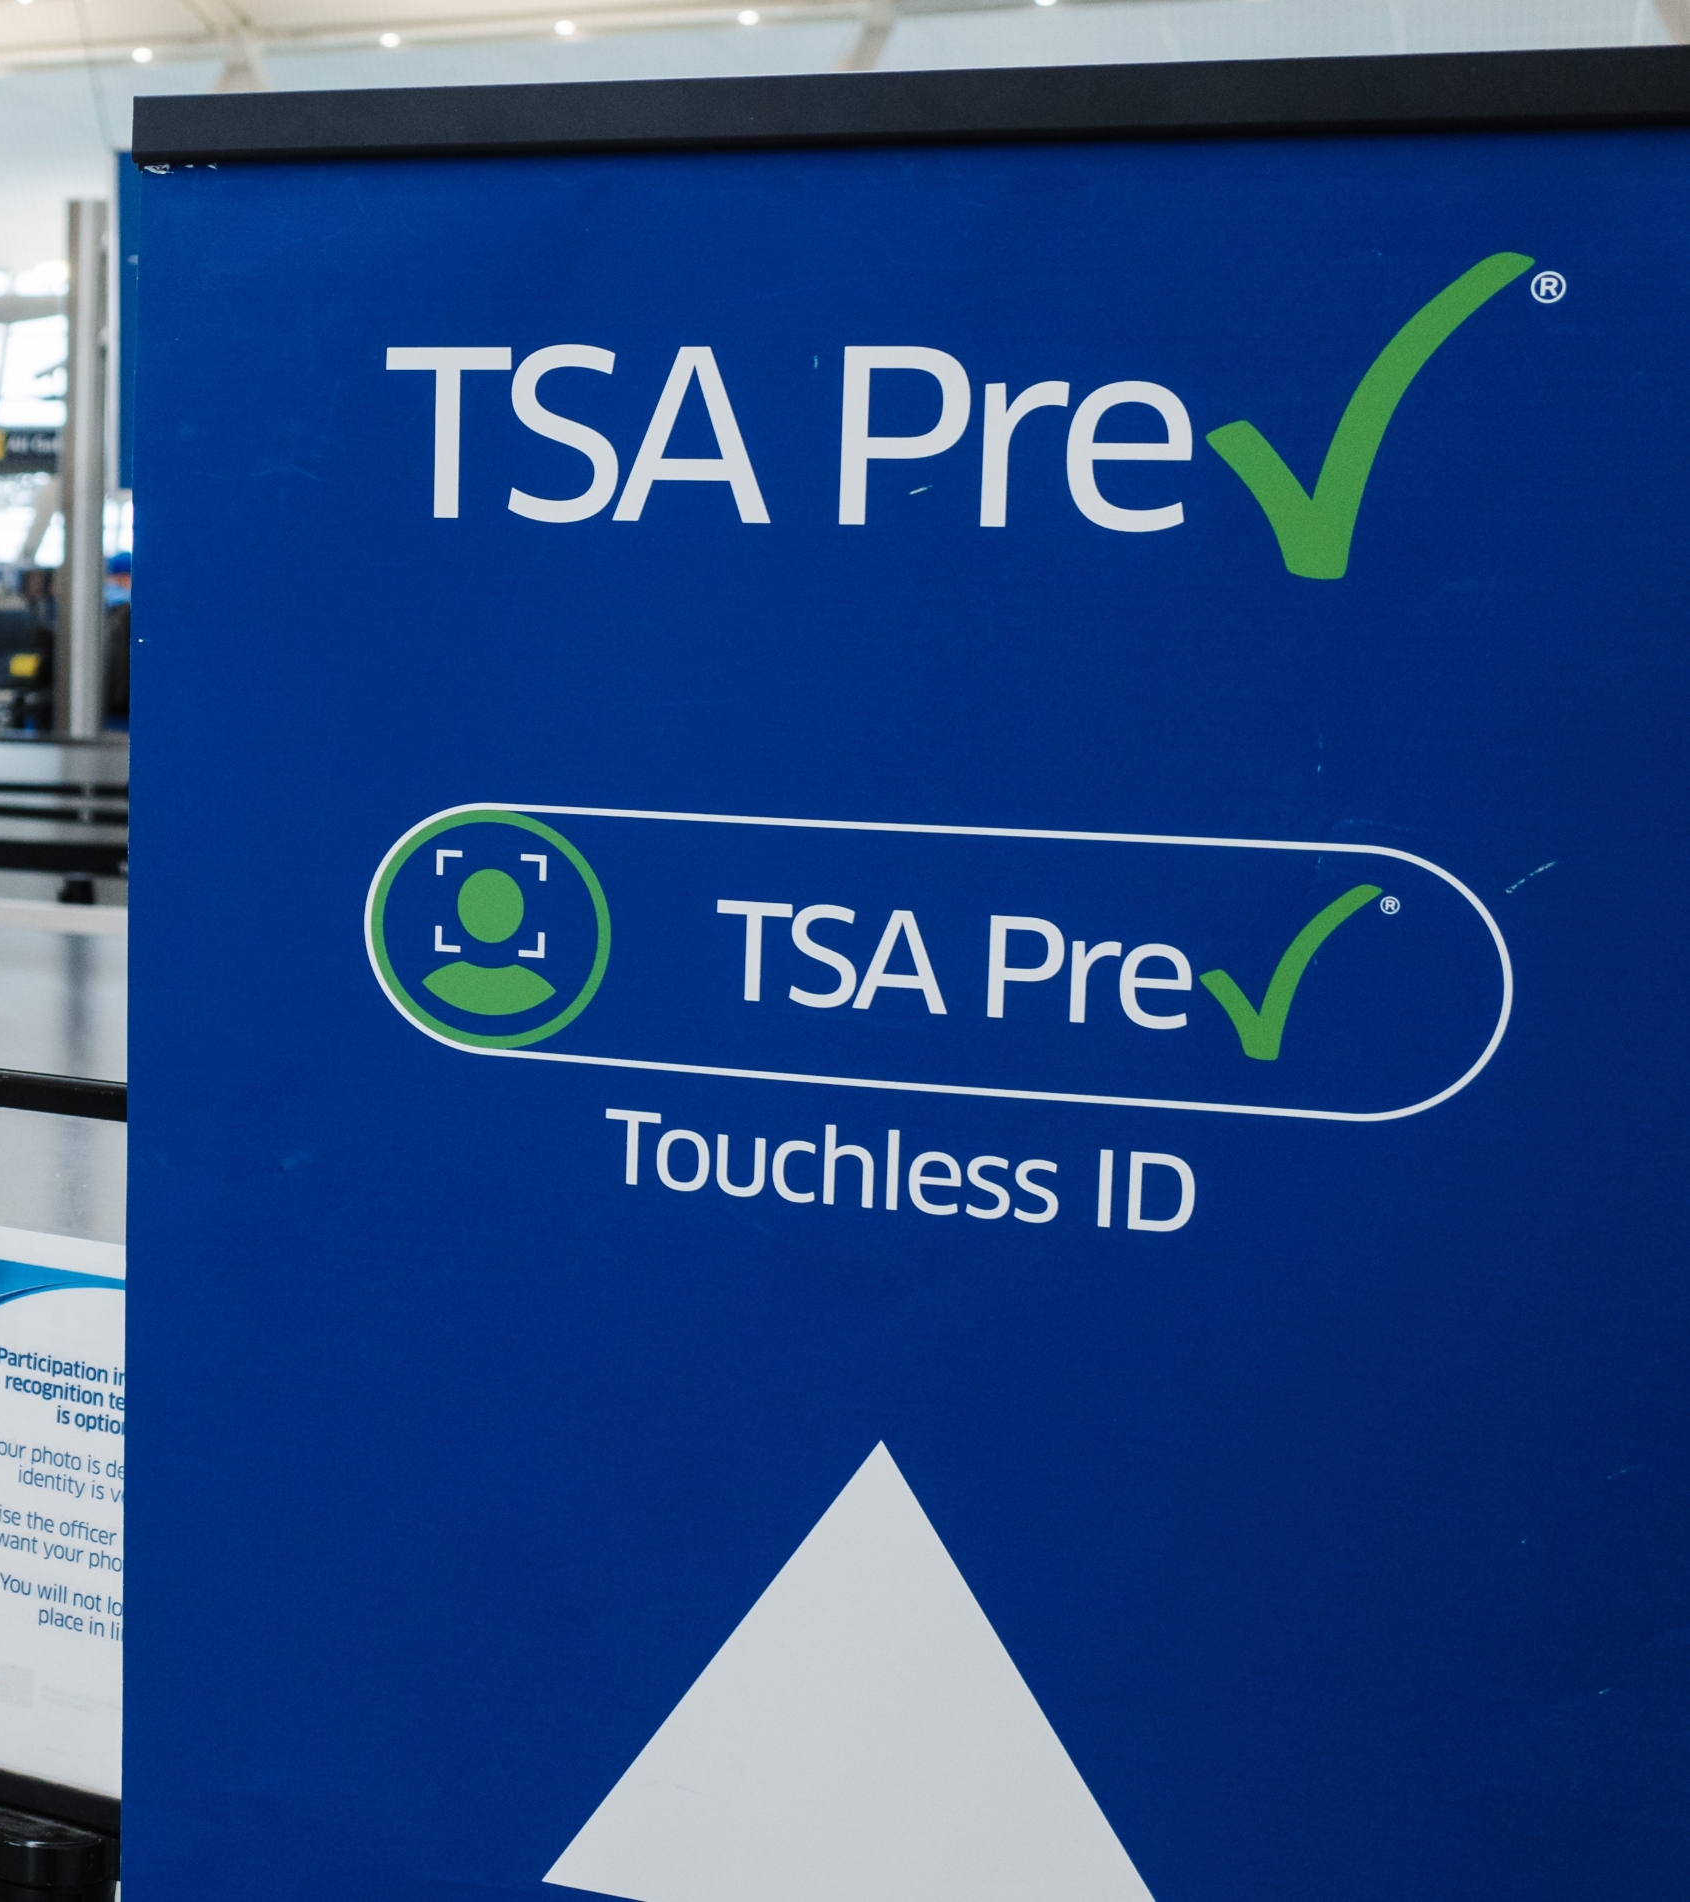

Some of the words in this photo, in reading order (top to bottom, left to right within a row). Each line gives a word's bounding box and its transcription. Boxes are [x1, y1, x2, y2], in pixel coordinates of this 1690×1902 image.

[385, 344, 771, 524] TSA
[838, 345, 1193, 533] Pre
[716, 899, 948, 1015] TSA
[986, 914, 1193, 1030] Pre
[605, 1108, 1059, 1224] Touchless
[1096, 1149, 1196, 1232] ID
[4, 1374, 104, 1407] recognition
[56, 1405, 70, 1425] is
[31, 1445, 82, 1471] photo
[87, 1454, 101, 1475] is
[18, 1464, 86, 1498] identity
[91, 1479, 105, 1500] is
[110, 1487, 124, 1503] v
[26, 1511, 54, 1534] the
[59, 1519, 117, 1546] officer
[43, 1541, 84, 1563] your
[0, 1572, 32, 1596] You
[37, 1583, 68, 1604] will
[73, 1591, 102, 1613] not
[38, 1607, 84, 1632] place
[88, 1616, 105, 1637] in
[110, 1621, 124, 1642] li
